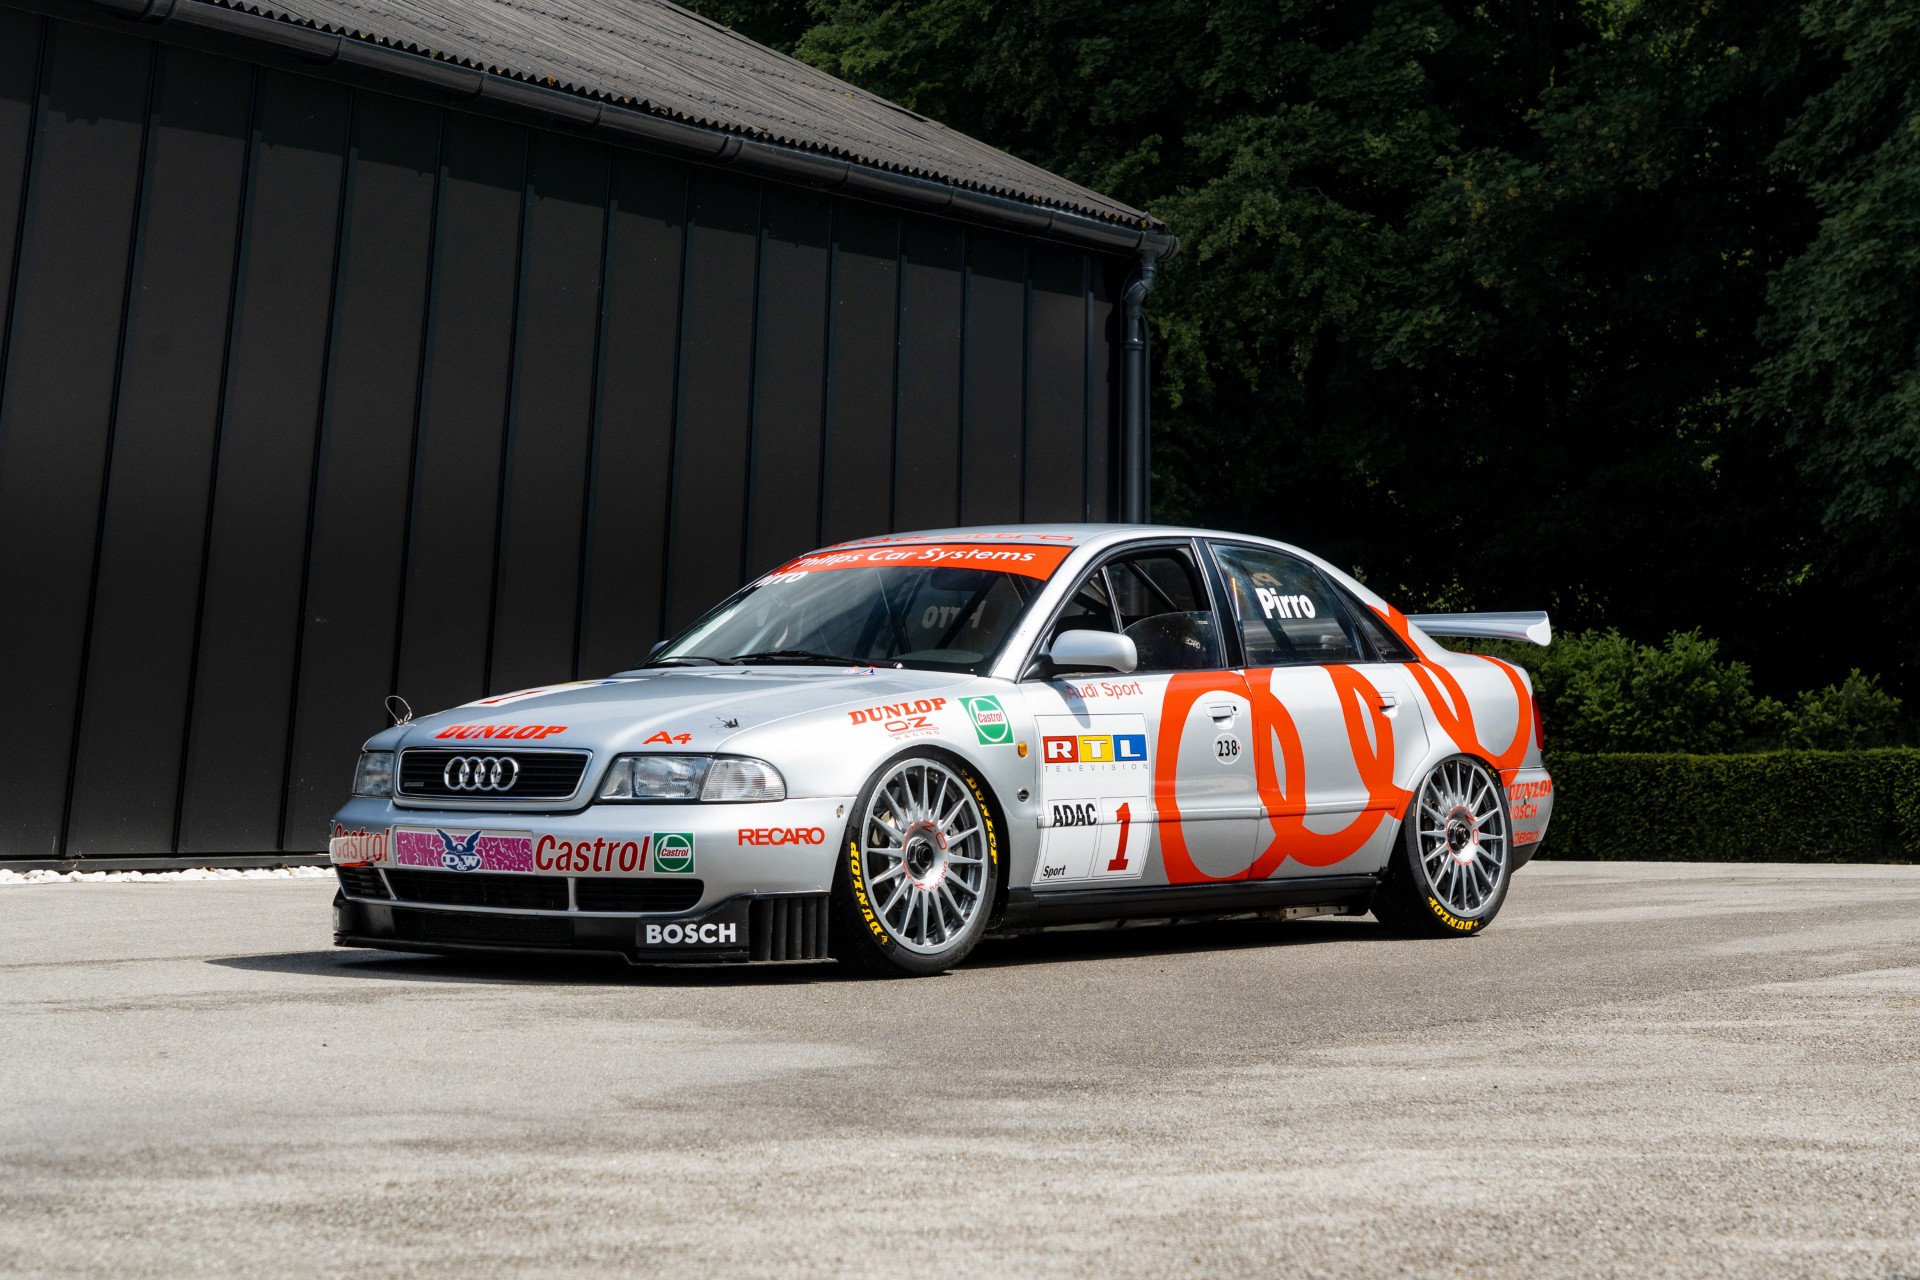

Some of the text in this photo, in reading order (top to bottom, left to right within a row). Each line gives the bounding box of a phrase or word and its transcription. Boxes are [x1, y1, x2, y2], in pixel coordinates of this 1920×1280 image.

[867, 548, 916, 561] Car
[918, 547, 1037, 562] Systems
[1255, 588, 1316, 619] Pirro
[1066, 681, 1144, 699] Audi Sport
[848, 697, 947, 725] DUNLOP
[977, 711, 1003, 723] Castrol
[435, 725, 568, 740] DUNLOP
[642, 730, 692, 745] A4
[894, 731, 940, 741] RACING
[1046, 738, 1143, 760] RTL
[1217, 740, 1238, 757] 238
[1045, 763, 1148, 773] TELEVISION
[1052, 803, 1097, 828] ADAC
[334, 823, 391, 862] Castrol
[738, 827, 825, 845] RECARO
[1107, 802, 1131, 871] 1
[535, 834, 651, 873] Castrol
[661, 848, 689, 857] Castrol
[445, 854, 479, 870] D&W
[1043, 865, 1066, 877] Sport
[850, 841, 883, 936] DUNLOP
[1428, 896, 1474, 930] DUNLOP
[646, 923, 736, 944] BOSCH
